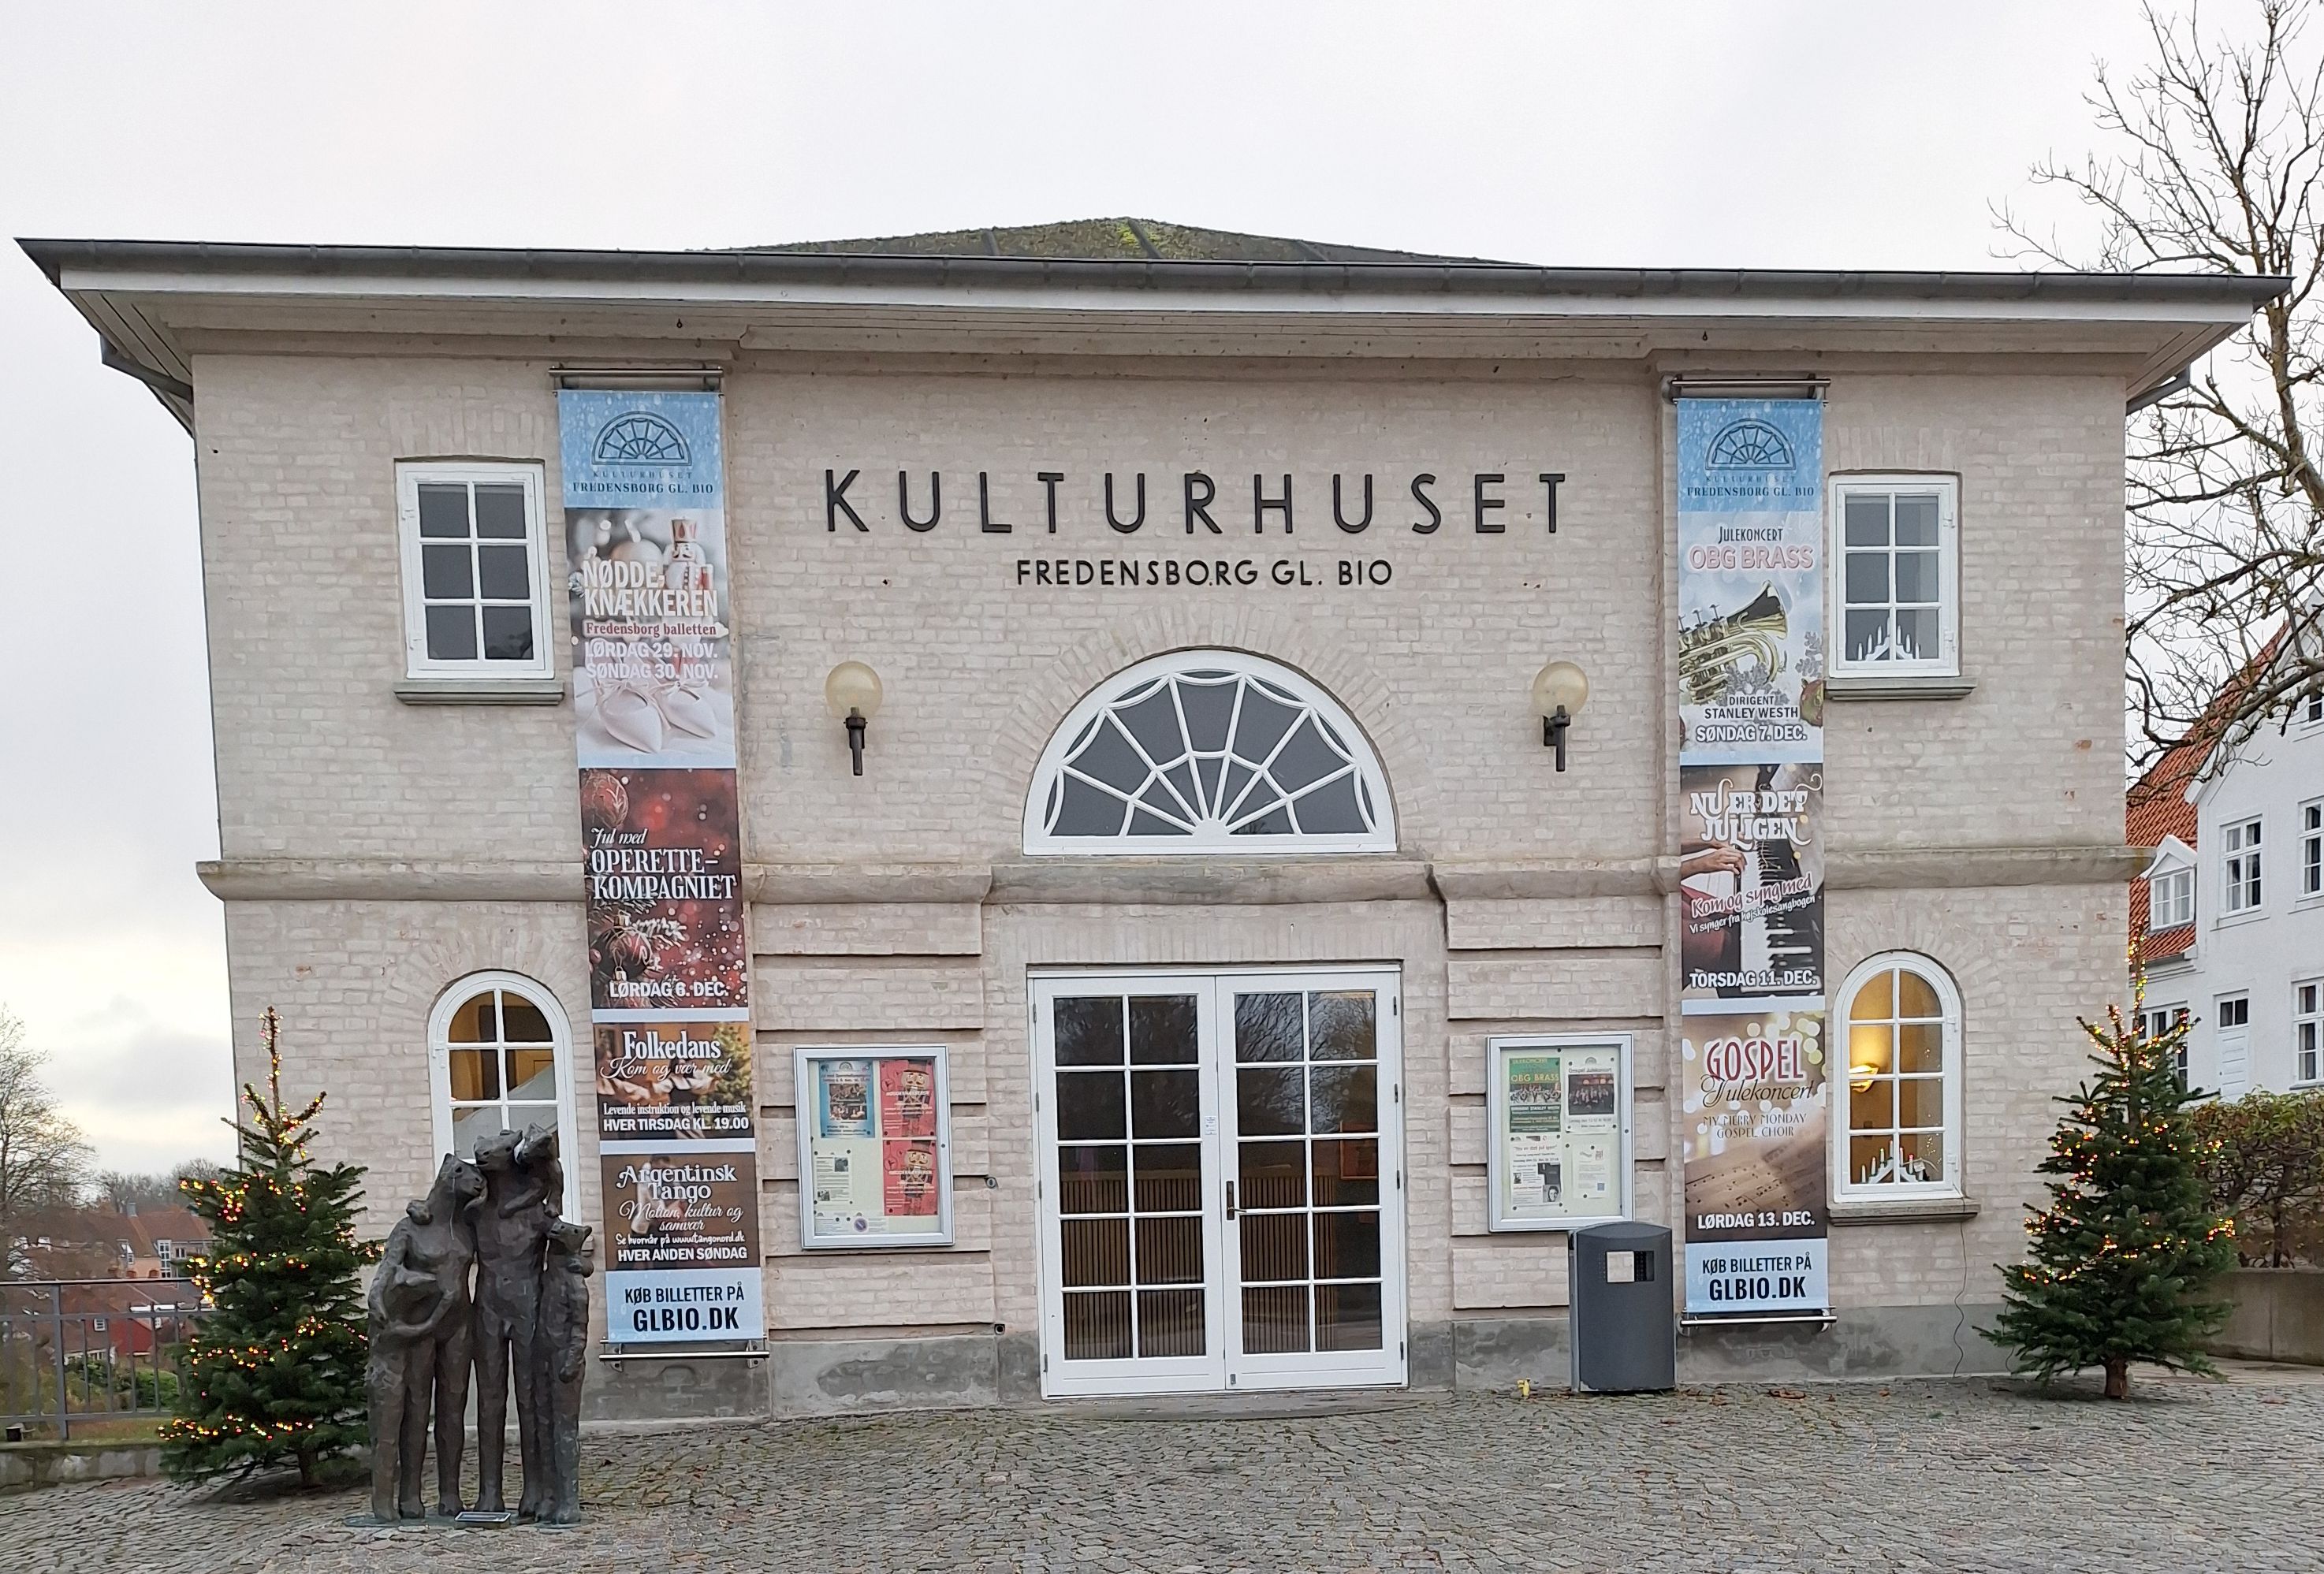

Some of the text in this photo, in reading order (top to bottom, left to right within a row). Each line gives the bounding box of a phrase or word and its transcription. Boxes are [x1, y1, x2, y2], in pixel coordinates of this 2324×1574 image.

[573, 482, 713, 493] FREDENSBORG GL. BIO
[1688, 487, 1814, 497] FREDENSBORG GL. BIO
[825, 470, 1566, 535] KULTURHUSET
[1718, 526, 1783, 544] JULEKONCERT
[1689, 545, 1814, 569] OBG BRASS
[1017, 560, 1393, 586] FREDENSBORG GL. BIO
[584, 589, 719, 617] KNÆKKEREN
[586, 622, 717, 638] Fredensborg balletten
[585, 642, 718, 658] LØRDAG 29. NOV.
[586, 663, 718, 679] SØNDAG 30. NOV.
[1729, 696, 1775, 705] DIRIGENT
[1704, 707, 1798, 719] STANLEY WESTH
[1696, 724, 1808, 742] SØNDAG 7. DEC.
[1690, 773, 1823, 820] NU ER DET
[590, 828, 648, 849] Jul med
[593, 874, 736, 899] KOMPAGNIET
[1692, 873, 1812, 917] Kom og syng med
[1689, 923, 1699, 934] Vi
[1700, 918, 1726, 932] synger
[1727, 914, 1740, 927] fra
[1689, 969, 1816, 988] TORSDAG 11. DEC.
[609, 981, 729, 998] LØRDAG 6. DEC.
[623, 1030, 721, 1059] Folkedans
[600, 1056, 732, 1081] Kom og vær med
[1707, 1040, 1804, 1081] GOSPEL
[1700, 1074, 1814, 1107] Julekoncert
[604, 1101, 746, 1116] Levende instruktion og levende musik
[604, 1118, 636, 1131] HVER
[638, 1118, 691, 1131] TIRSDAG
[714, 1117, 749, 1129] 19.00
[1704, 1113, 1807, 1126] MY MERRY MONDAY
[1717, 1126, 1793, 1138] GOSPEL CHOIR
[616, 1164, 738, 1189] Argentinsk
[648, 1182, 712, 1204] Tango
[684, 1203, 724, 1218] kultur
[726, 1207, 743, 1222] og
[1697, 1211, 1816, 1230] LØRDAG 13. DEC.
[616, 1233, 626, 1245] Se
[660, 1234, 670, 1248] på
[618, 1247, 747, 1261] HVER ANDEN SØNDAG
[1702, 1252, 1812, 1275] KØB BILLETTER PÅ
[625, 1281, 744, 1305] KØB BILLETTER PÅ
[1709, 1276, 1806, 1301] GLBIO.DK
[633, 1307, 739, 1332] GLBIO.DK
